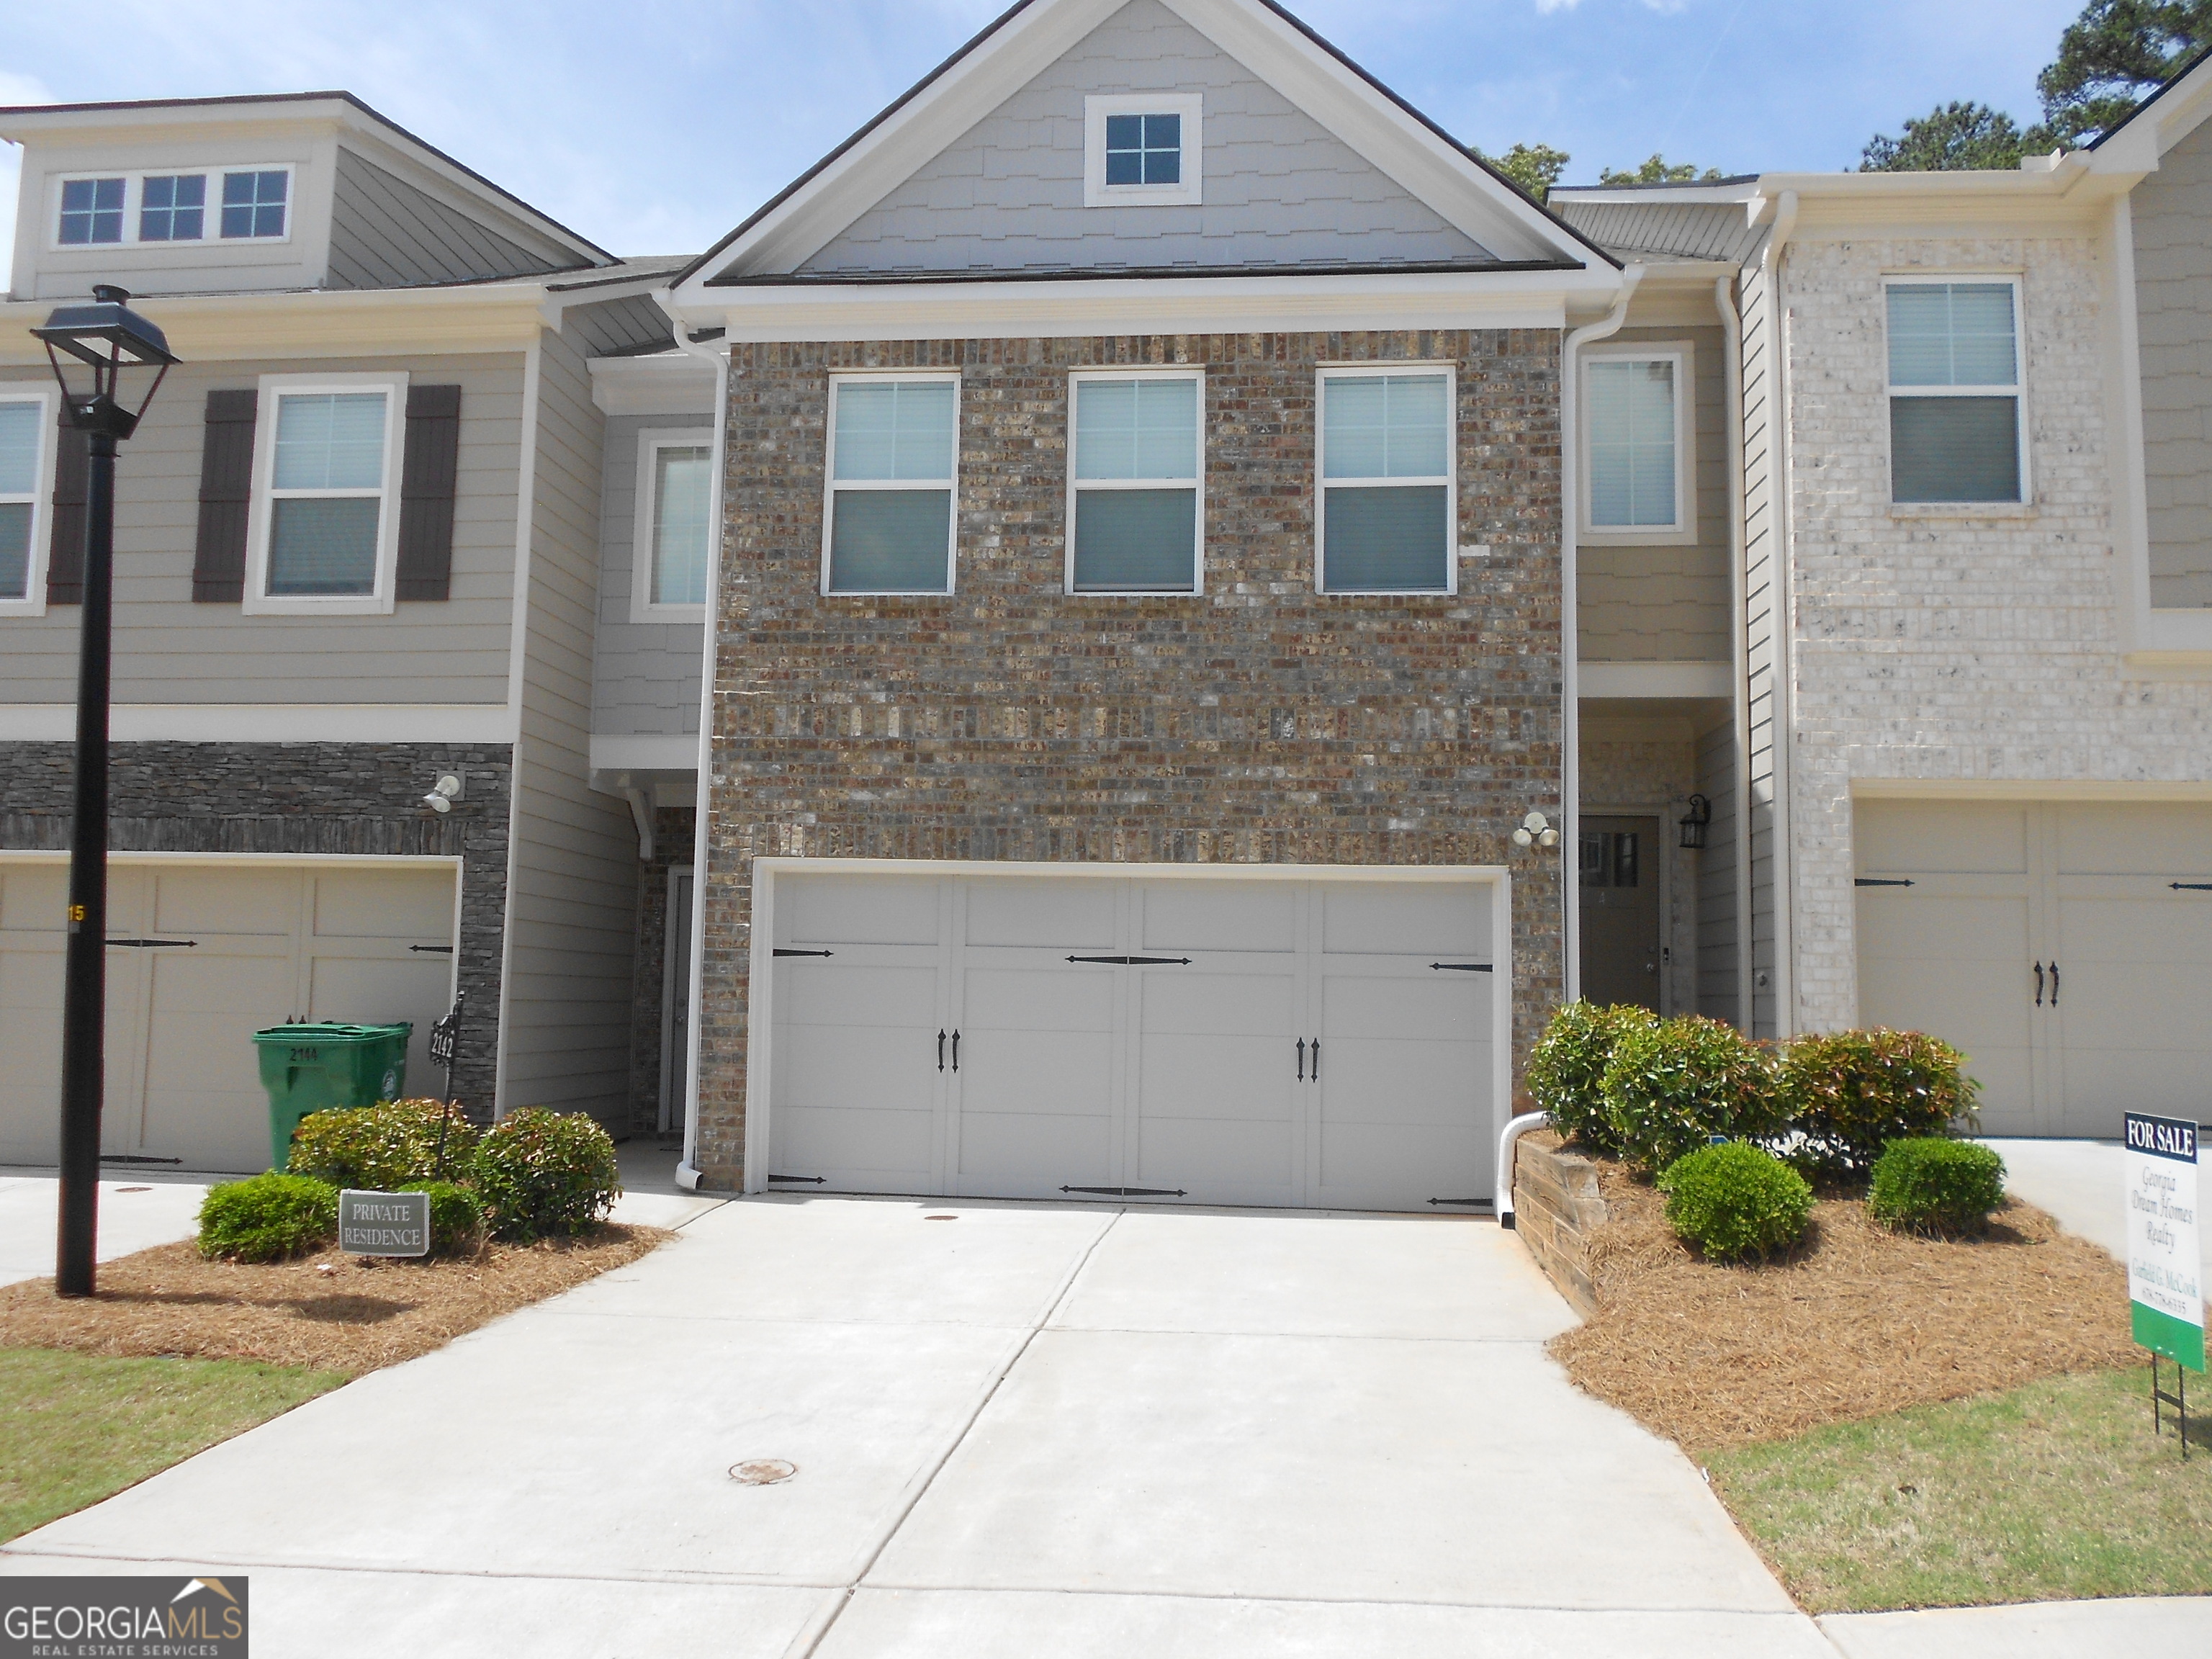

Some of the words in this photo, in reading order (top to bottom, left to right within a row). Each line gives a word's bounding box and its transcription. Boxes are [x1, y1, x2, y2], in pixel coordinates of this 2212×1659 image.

[289, 1048, 318, 1061] 2144
[431, 1032, 454, 1058] 2142
[2127, 1120, 2155, 1149] FOR
[2157, 1125, 2194, 1157] SALE
[2142, 1166, 2176, 1197] Georgia
[353, 1203, 410, 1222] PRIVATE
[2131, 1190, 2158, 1215] Dream
[2159, 1197, 2193, 1224] Homes
[344, 1227, 421, 1246] RESIDENCE
[2146, 1220, 2175, 1254] Realty
